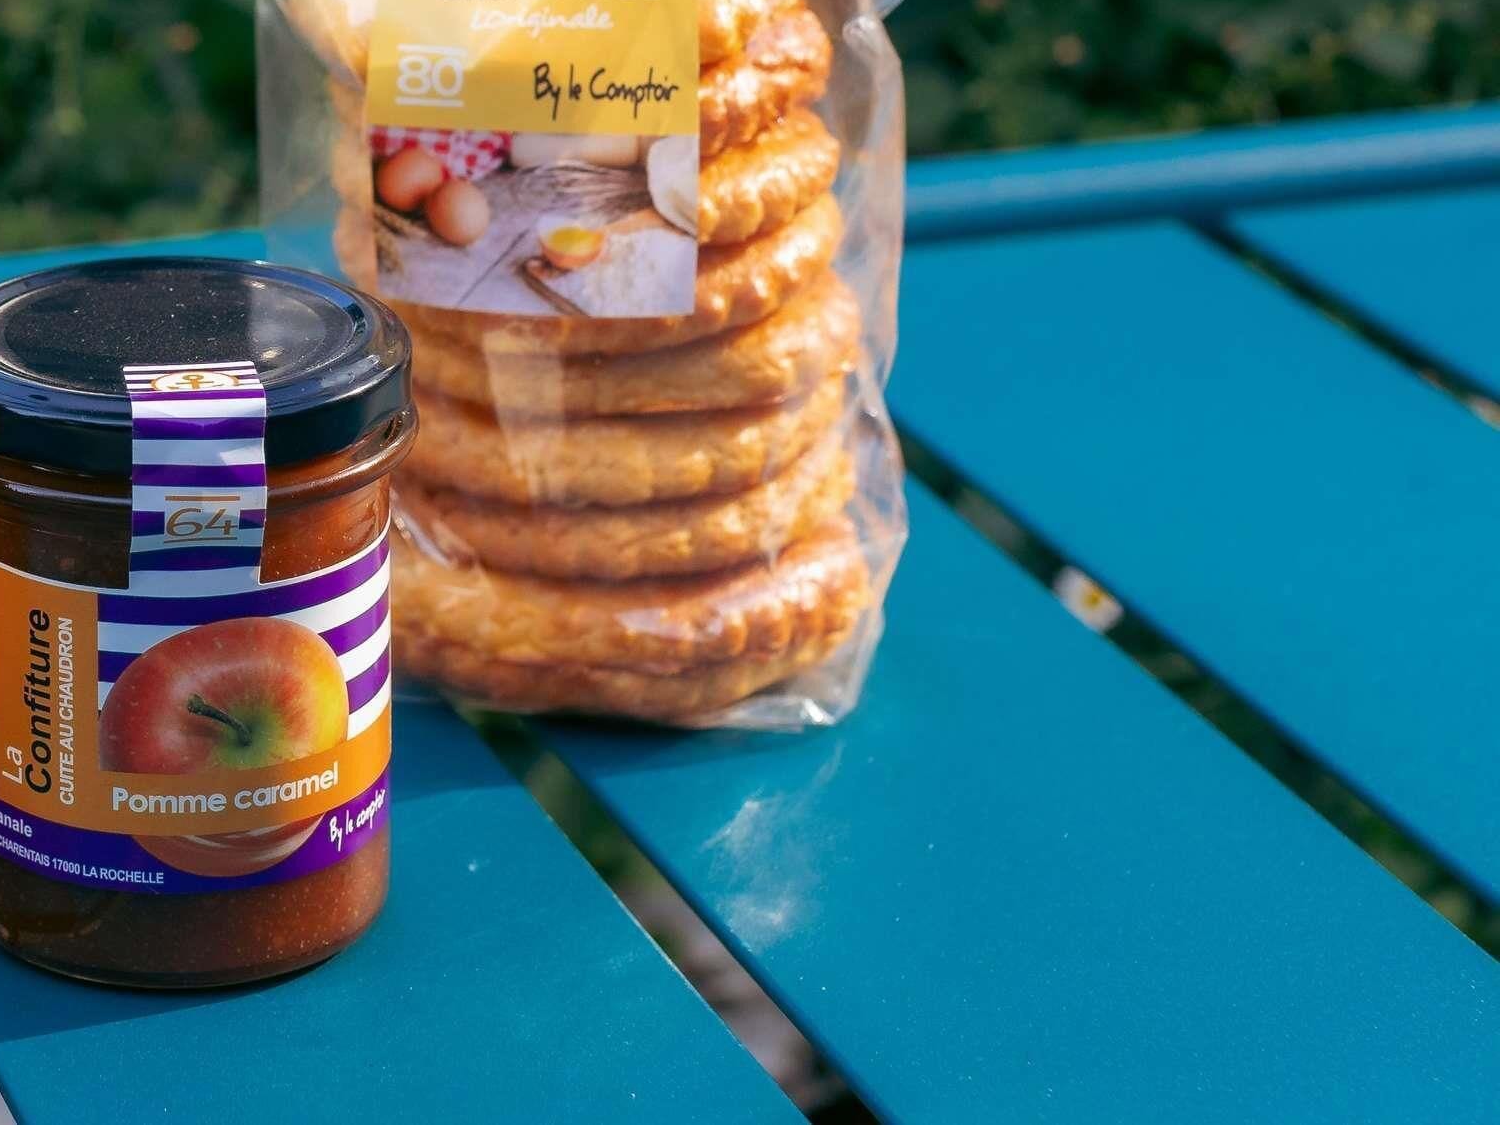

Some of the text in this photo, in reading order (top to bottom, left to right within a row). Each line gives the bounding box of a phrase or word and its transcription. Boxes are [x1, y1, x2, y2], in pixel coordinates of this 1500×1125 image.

[396, 55, 464, 97] 80
[534, 62, 678, 120] By le Comptoir
[164, 506, 238, 537] 64
[24, 608, 52, 794] Confiture
[58, 617, 75, 806] CUITE AU CHAUDRON
[2, 745, 23, 785] La
[111, 763, 340, 814] Pomme caramel
[329, 815, 343, 852] By
[51, 858, 81, 876] 17000
[82, 864, 99, 880] LA
[100, 866, 165, 885] ROCHELLE
